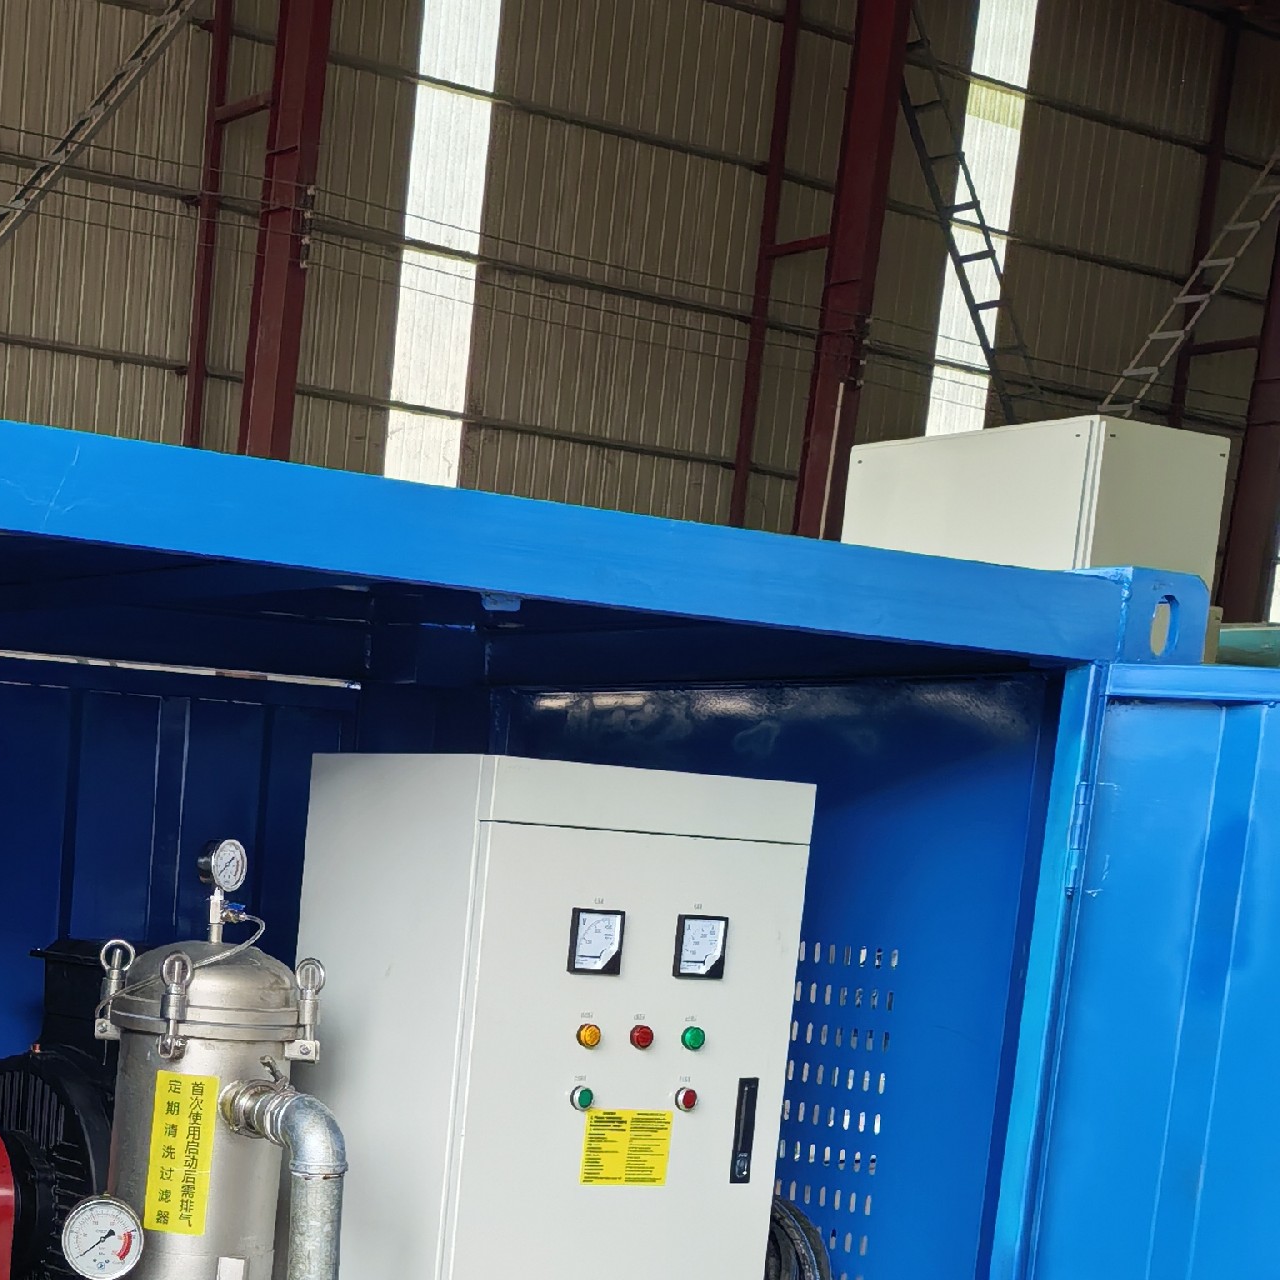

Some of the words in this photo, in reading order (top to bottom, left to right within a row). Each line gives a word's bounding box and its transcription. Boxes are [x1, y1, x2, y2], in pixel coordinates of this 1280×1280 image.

[155, 1079, 182, 1226] 定期清洗过滤器
[178, 1081, 206, 1228] 首次使用启动后需排气
